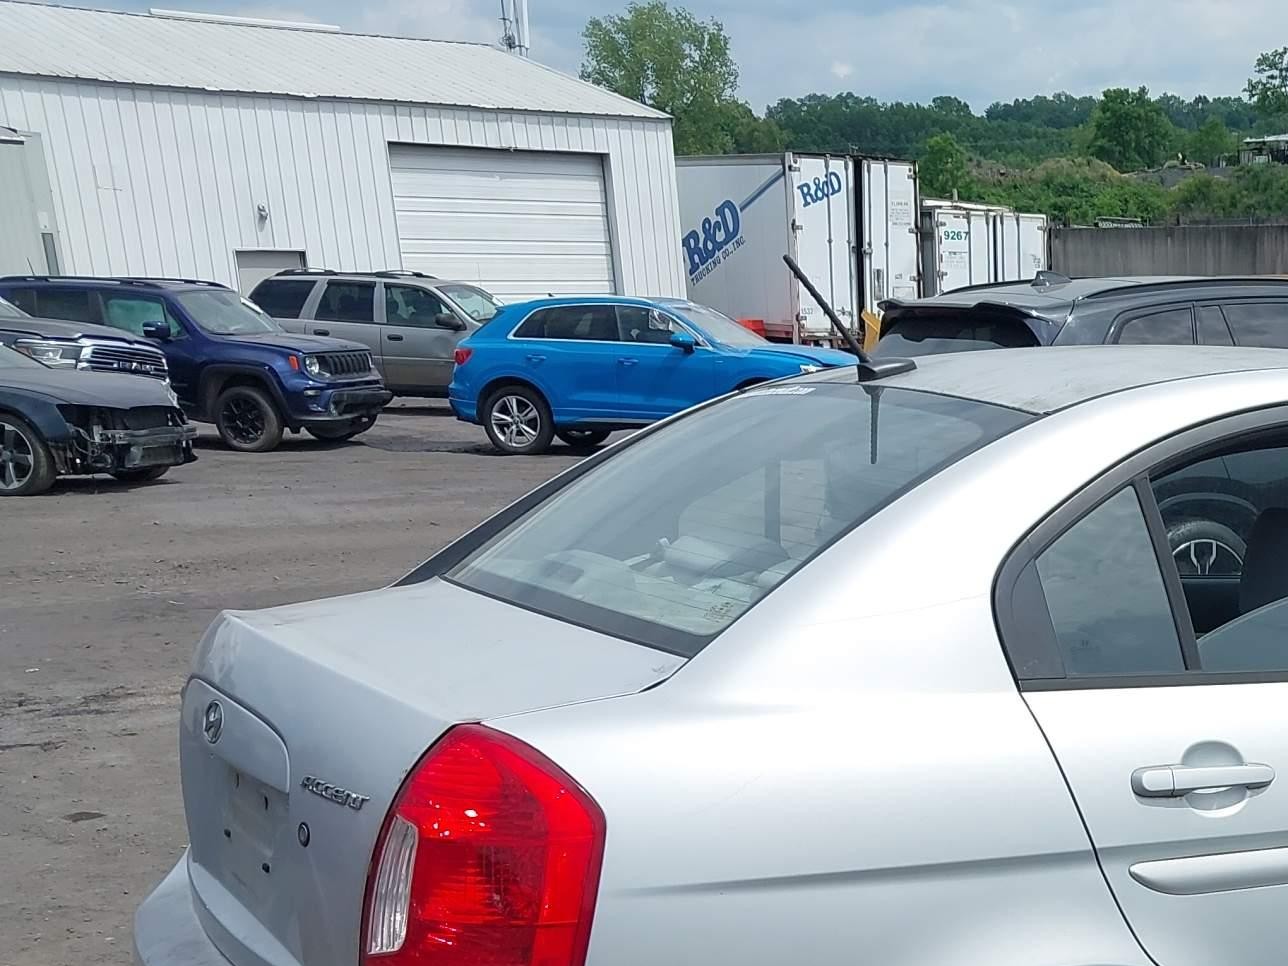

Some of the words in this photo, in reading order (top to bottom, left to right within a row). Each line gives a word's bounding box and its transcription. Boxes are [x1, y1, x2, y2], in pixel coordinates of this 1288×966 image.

[797, 171, 842, 208] R&D
[682, 199, 740, 276] R&D
[943, 230, 969, 241] 9267
[691, 255, 722, 286] TRUCKING
